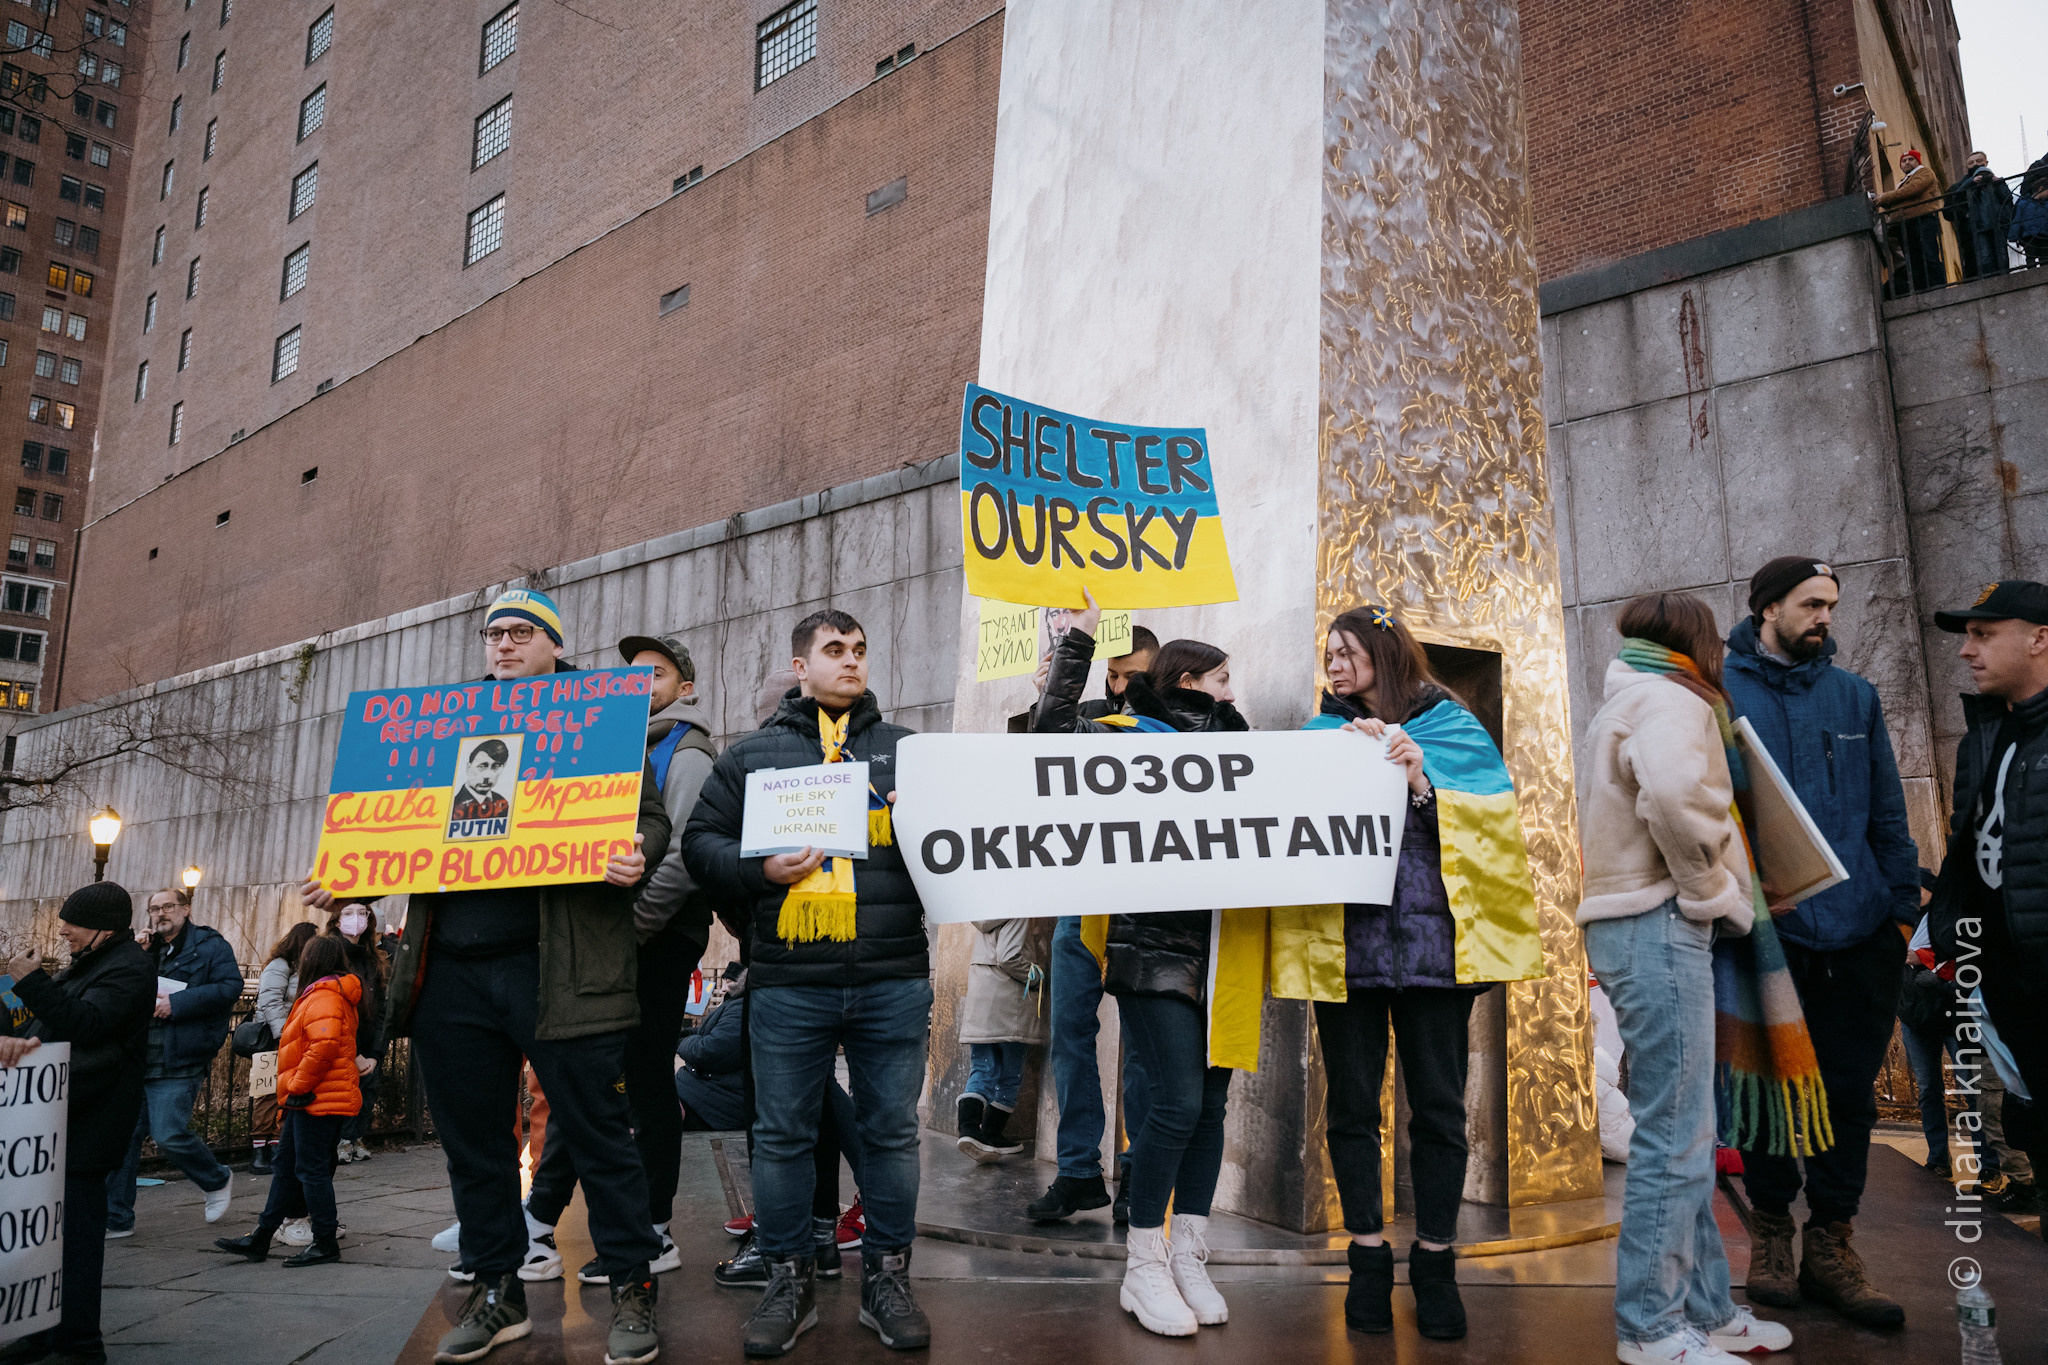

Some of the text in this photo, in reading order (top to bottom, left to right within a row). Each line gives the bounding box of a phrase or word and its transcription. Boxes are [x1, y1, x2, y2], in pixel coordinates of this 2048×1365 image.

[966, 394, 1210, 495] SHELTER
[981, 607, 1040, 643] TYRANT
[979, 637, 1033, 673] ХУЙЛО
[363, 672, 651, 723] DO NOT LET HISTORY
[380, 706, 603, 743] REPEAT ITSELF
[763, 774, 852, 791] NATO CLOSE
[1035, 754, 1254, 796] ПОЗОР
[325, 778, 439, 829] Слава
[453, 799, 509, 820] STOP
[777, 790, 837, 804] THE SKY
[786, 806, 825, 818] OVER
[448, 819, 508, 838] PUTIN
[773, 822, 837, 834] UKRAINE
[921, 815, 1392, 875] ОККУПАНТАМ!
[330, 848, 434, 891] STOP
[439, 838, 634, 886] BLOODSHED
[0, 1132, 58, 1180] СЬ!
